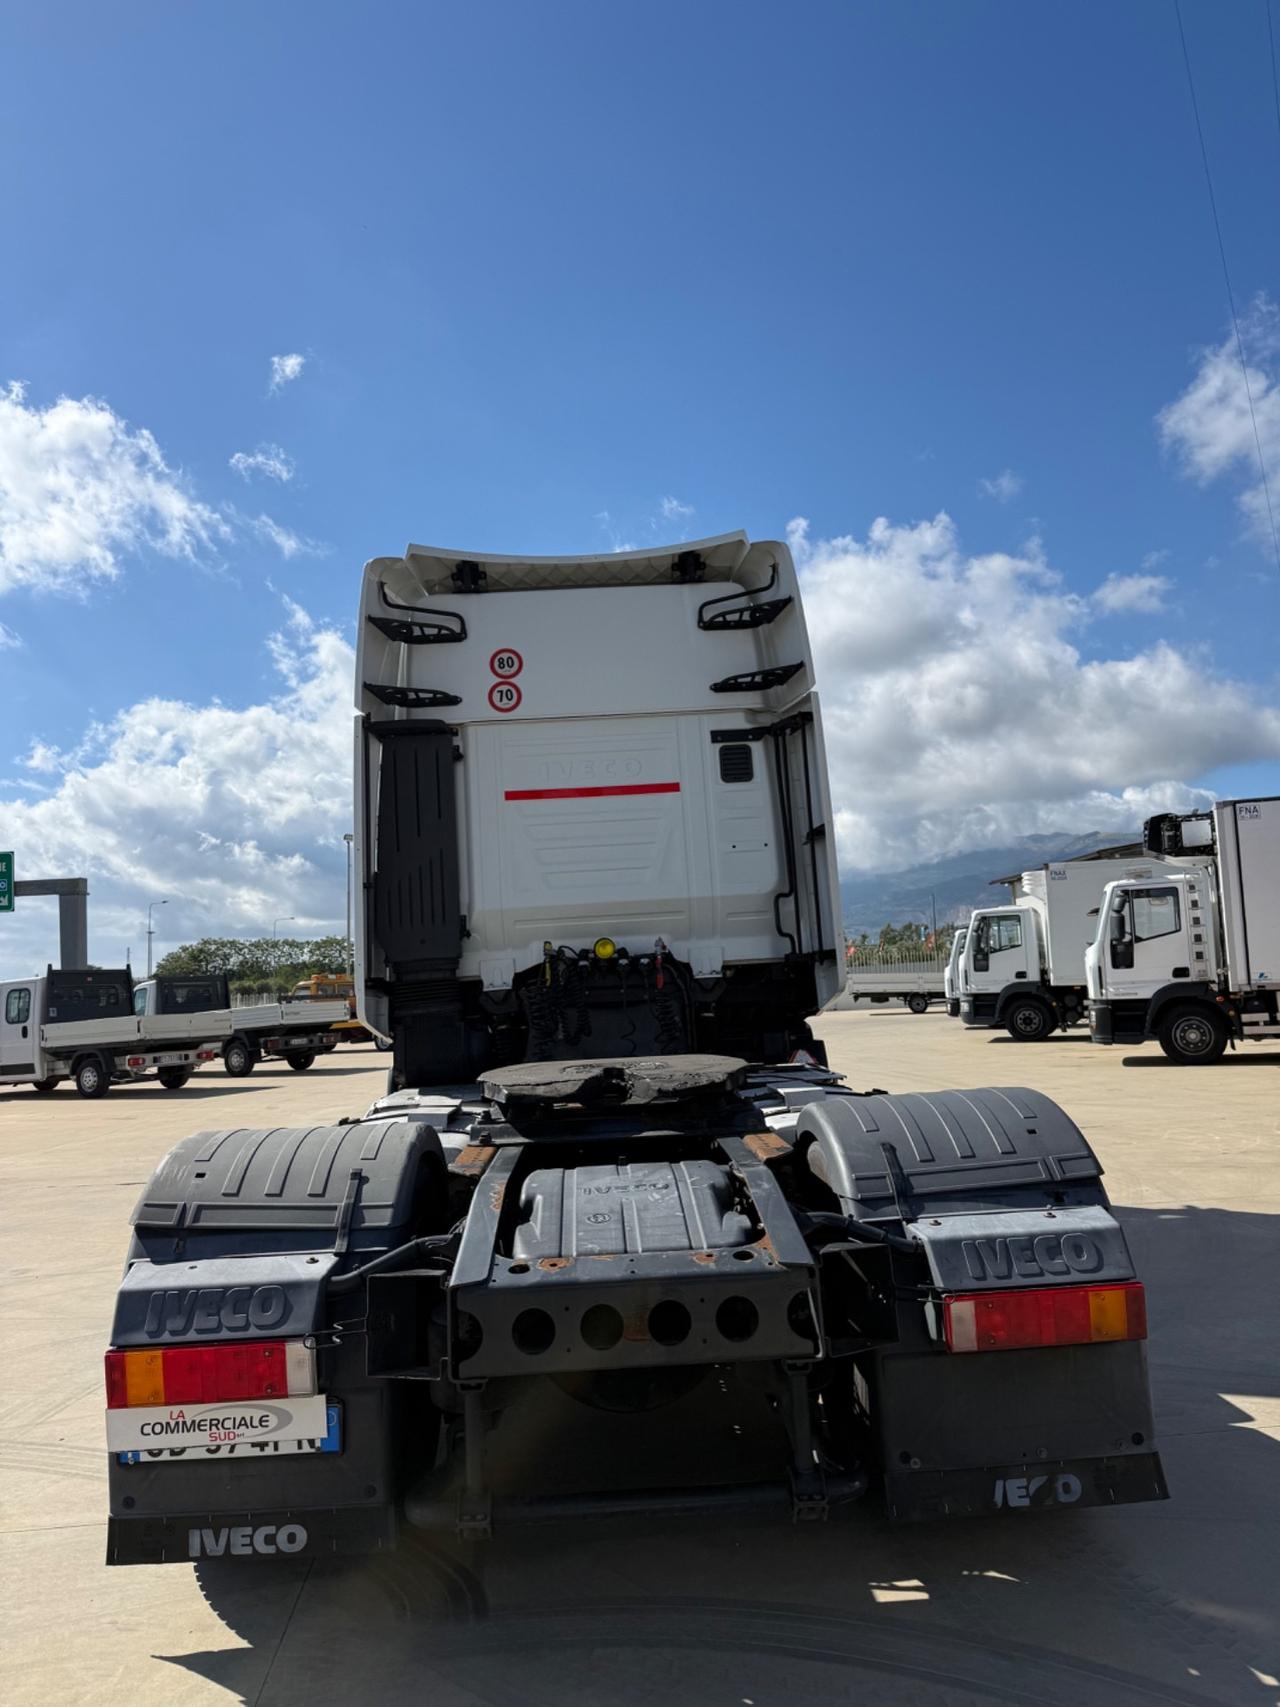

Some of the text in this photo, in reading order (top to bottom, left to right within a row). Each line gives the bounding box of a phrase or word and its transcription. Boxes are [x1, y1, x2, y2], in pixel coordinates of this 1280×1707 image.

[497, 656, 515, 669] 80
[496, 688, 514, 703] 70
[961, 1232, 1103, 1280] IVECO
[145, 1285, 291, 1337] IVECO
[169, 1410, 186, 1420] LA
[140, 1414, 270, 1436] COMMERCIALE
[208, 1431, 236, 1442] SUD
[189, 1524, 307, 1557] IVECO
